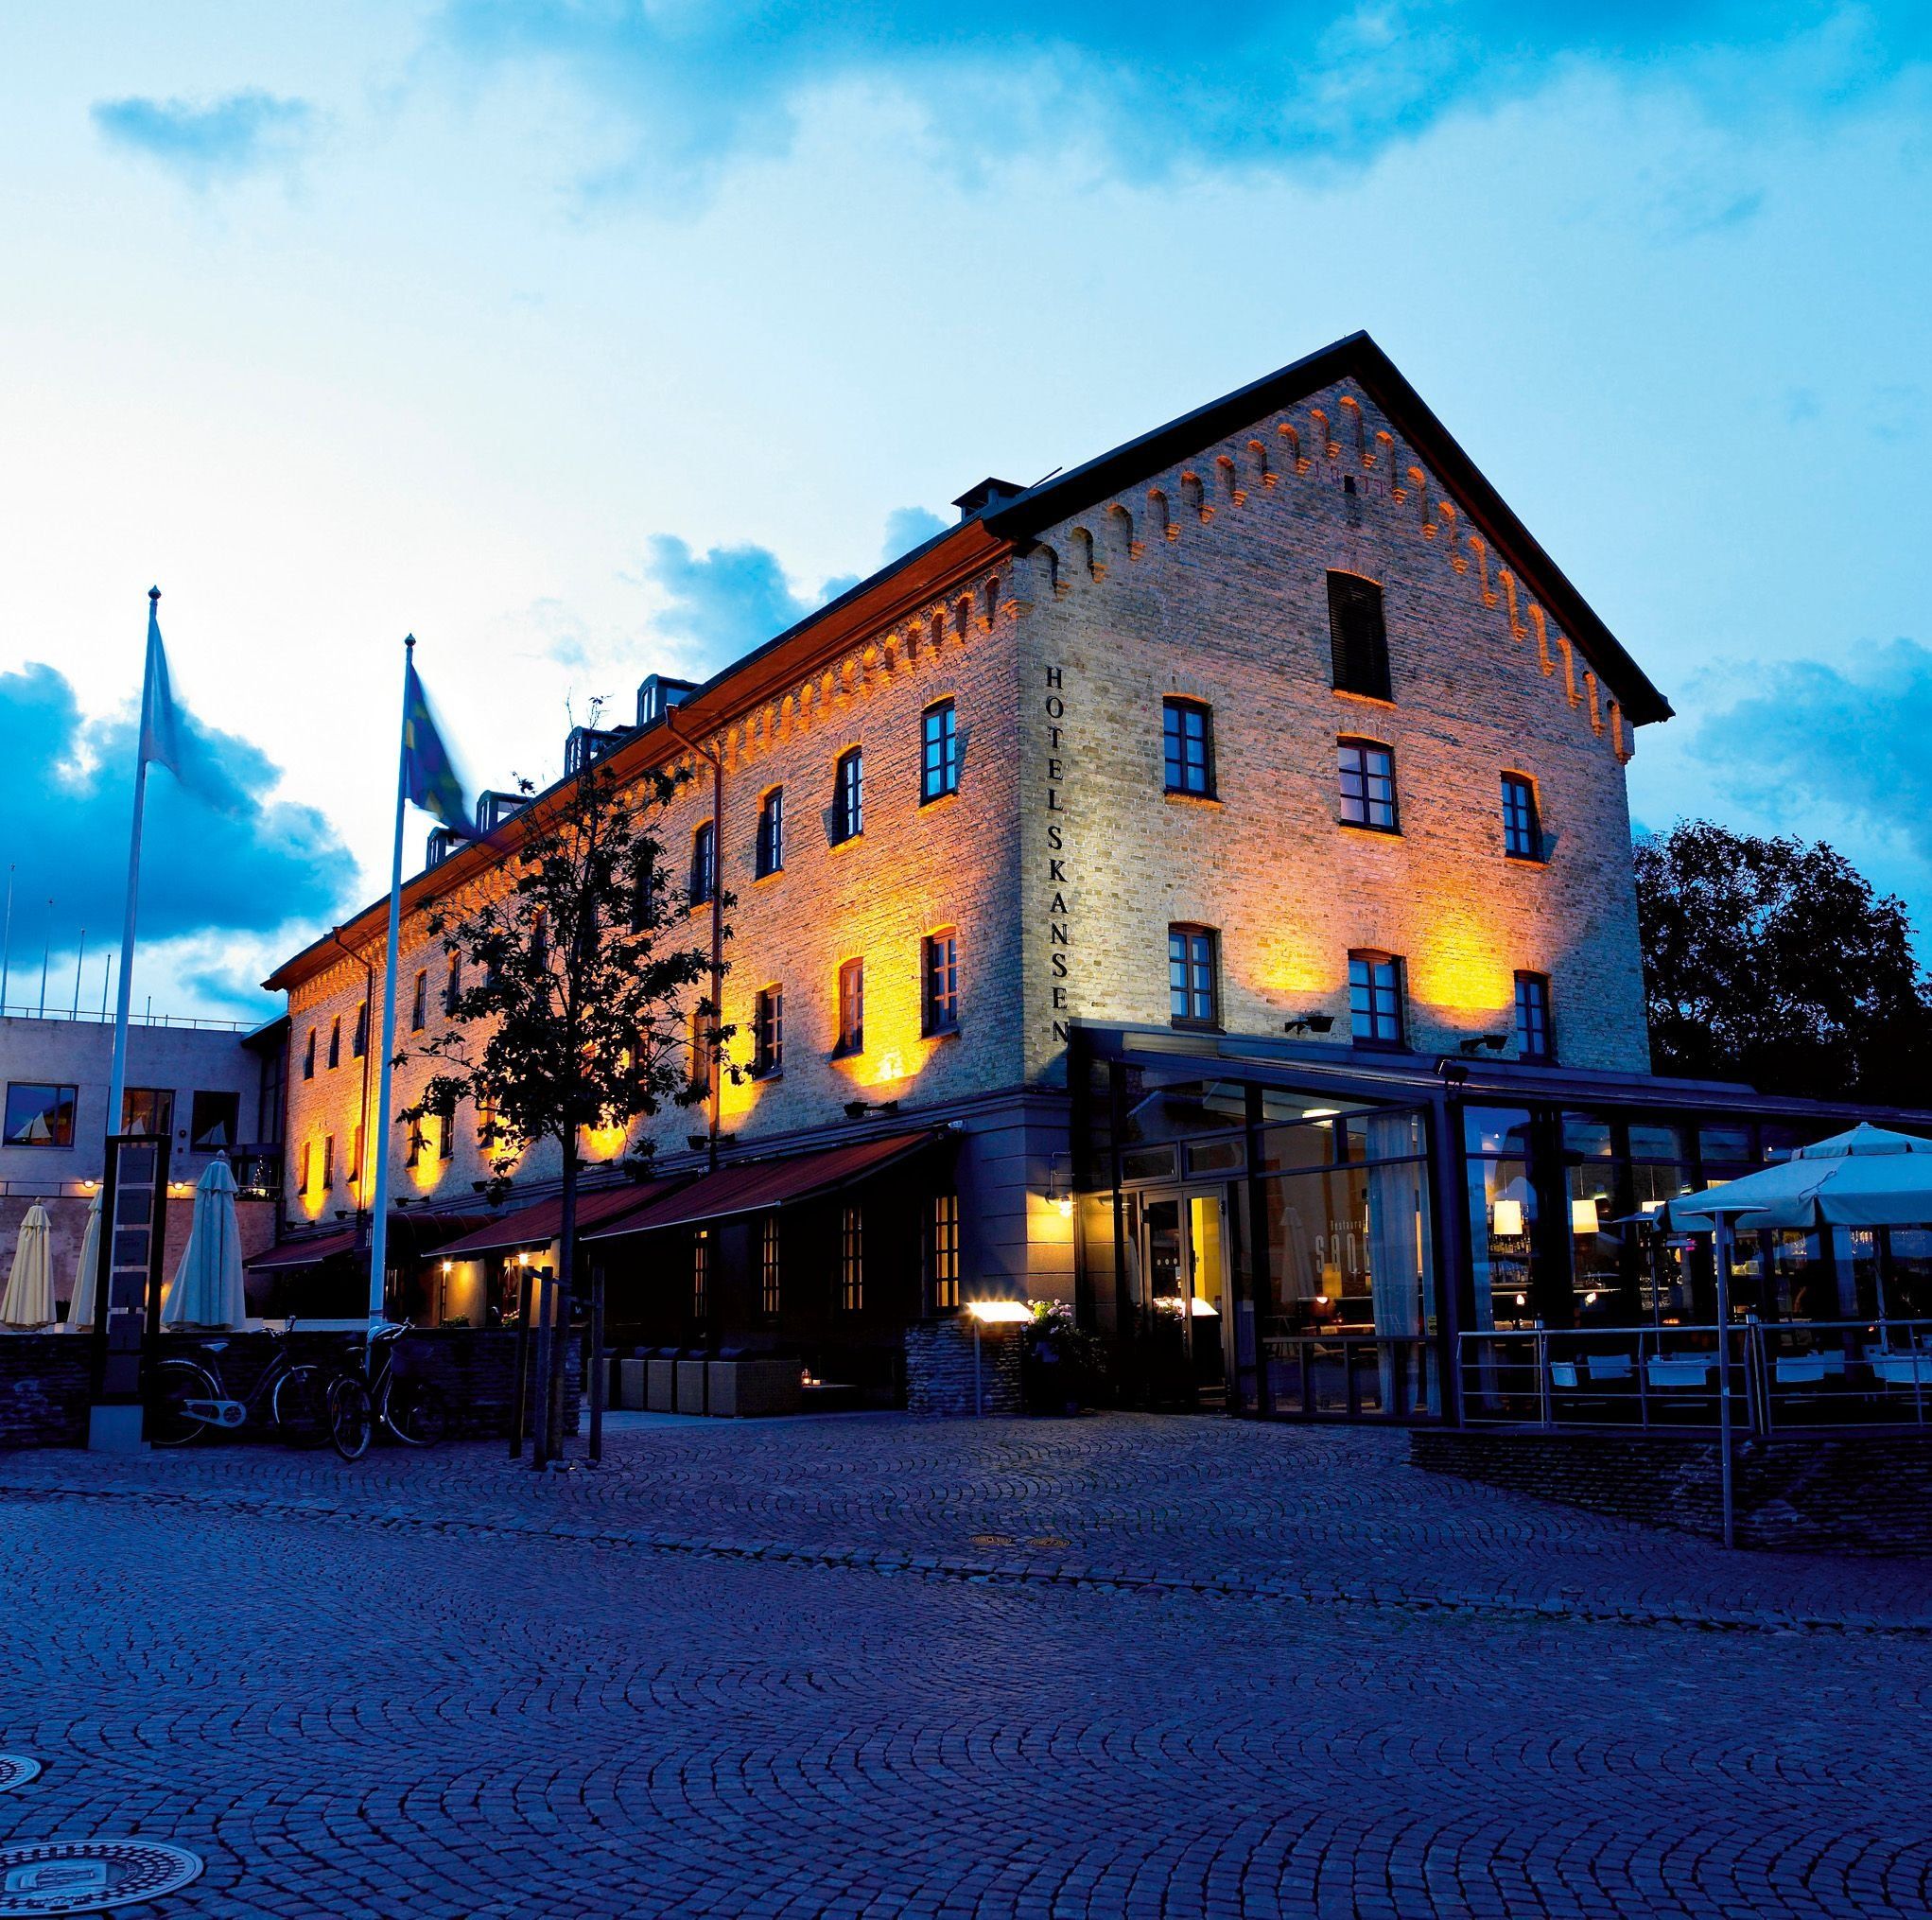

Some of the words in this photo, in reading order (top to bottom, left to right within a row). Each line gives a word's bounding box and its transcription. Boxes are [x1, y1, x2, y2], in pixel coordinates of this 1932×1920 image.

[1046, 666, 1065, 812] HOTEL
[1048, 825, 1070, 1042] SKANSEN
[1330, 1219, 1368, 1231] Restaura
